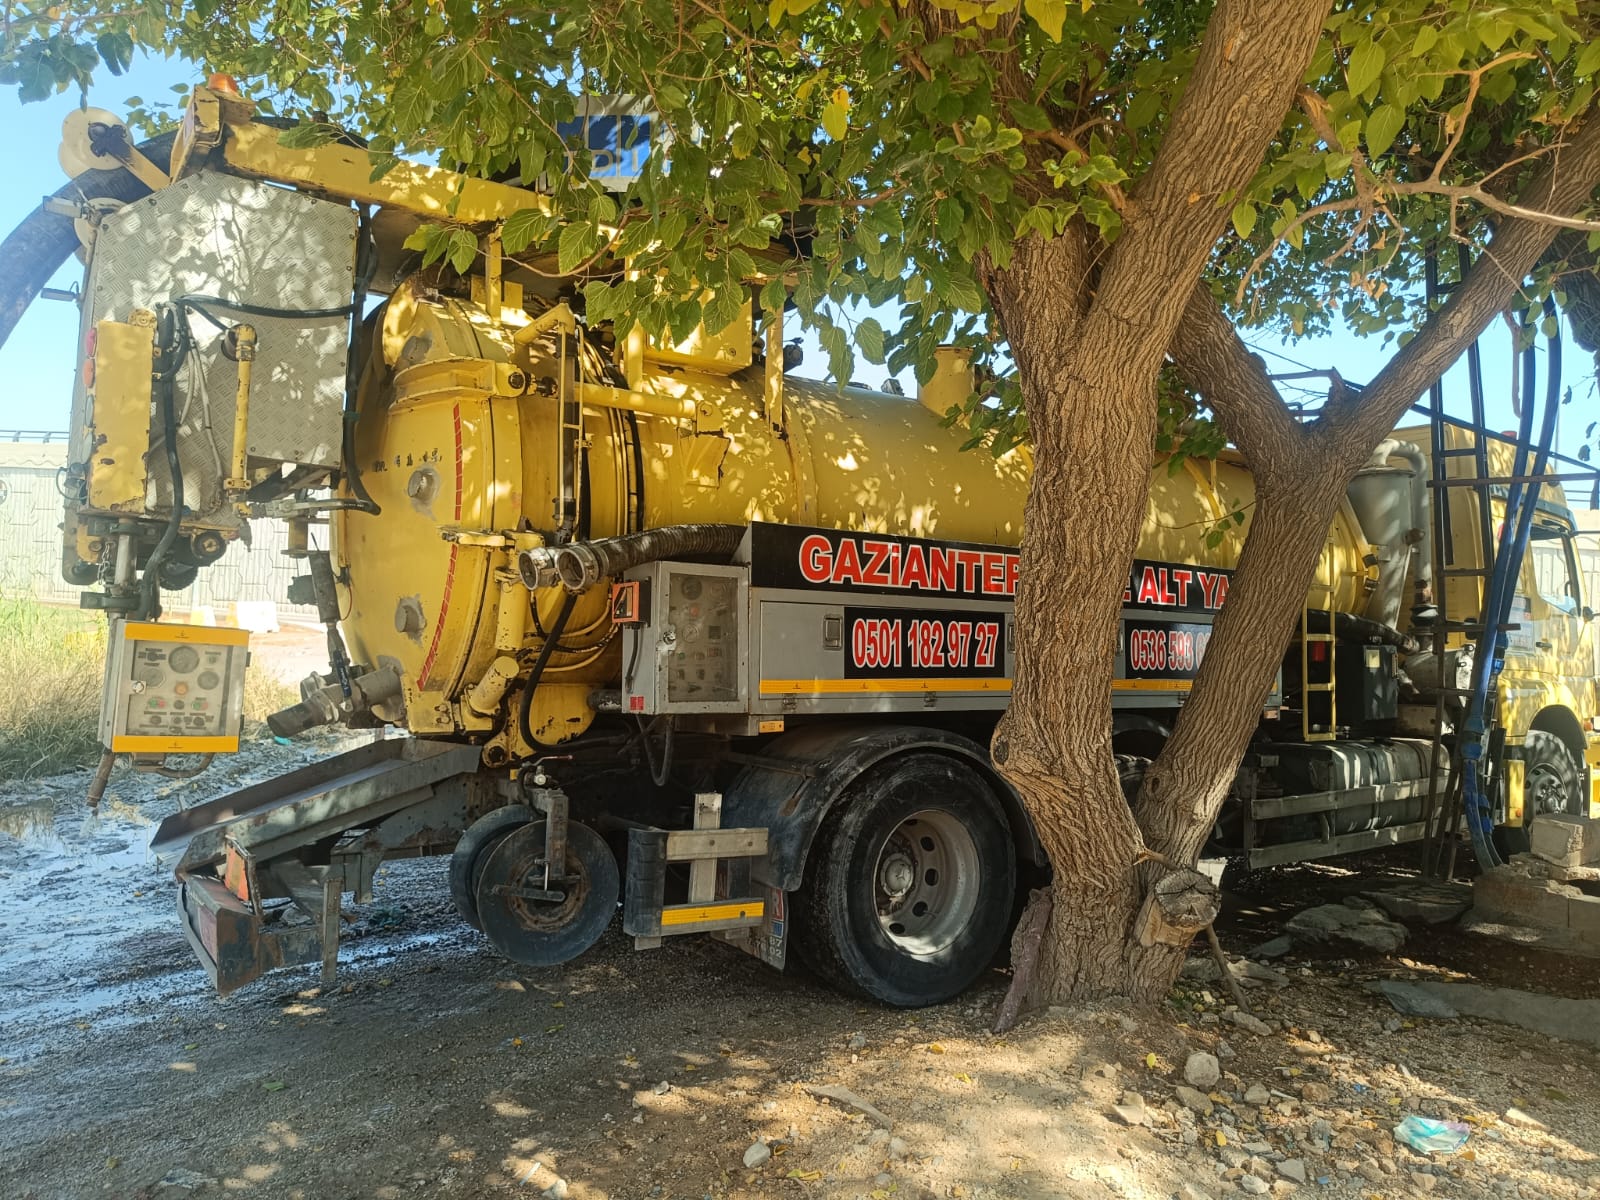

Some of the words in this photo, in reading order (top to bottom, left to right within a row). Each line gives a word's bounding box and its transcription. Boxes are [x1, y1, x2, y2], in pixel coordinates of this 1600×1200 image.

[1137, 565, 1192, 607] ALT
[852, 618, 902, 668] 0501
[908, 619, 945, 668] 182
[947, 621, 973, 668] 97
[974, 622, 999, 668] 27
[1131, 628, 1166, 671] 0536
[1168, 630, 1194, 671] 593
